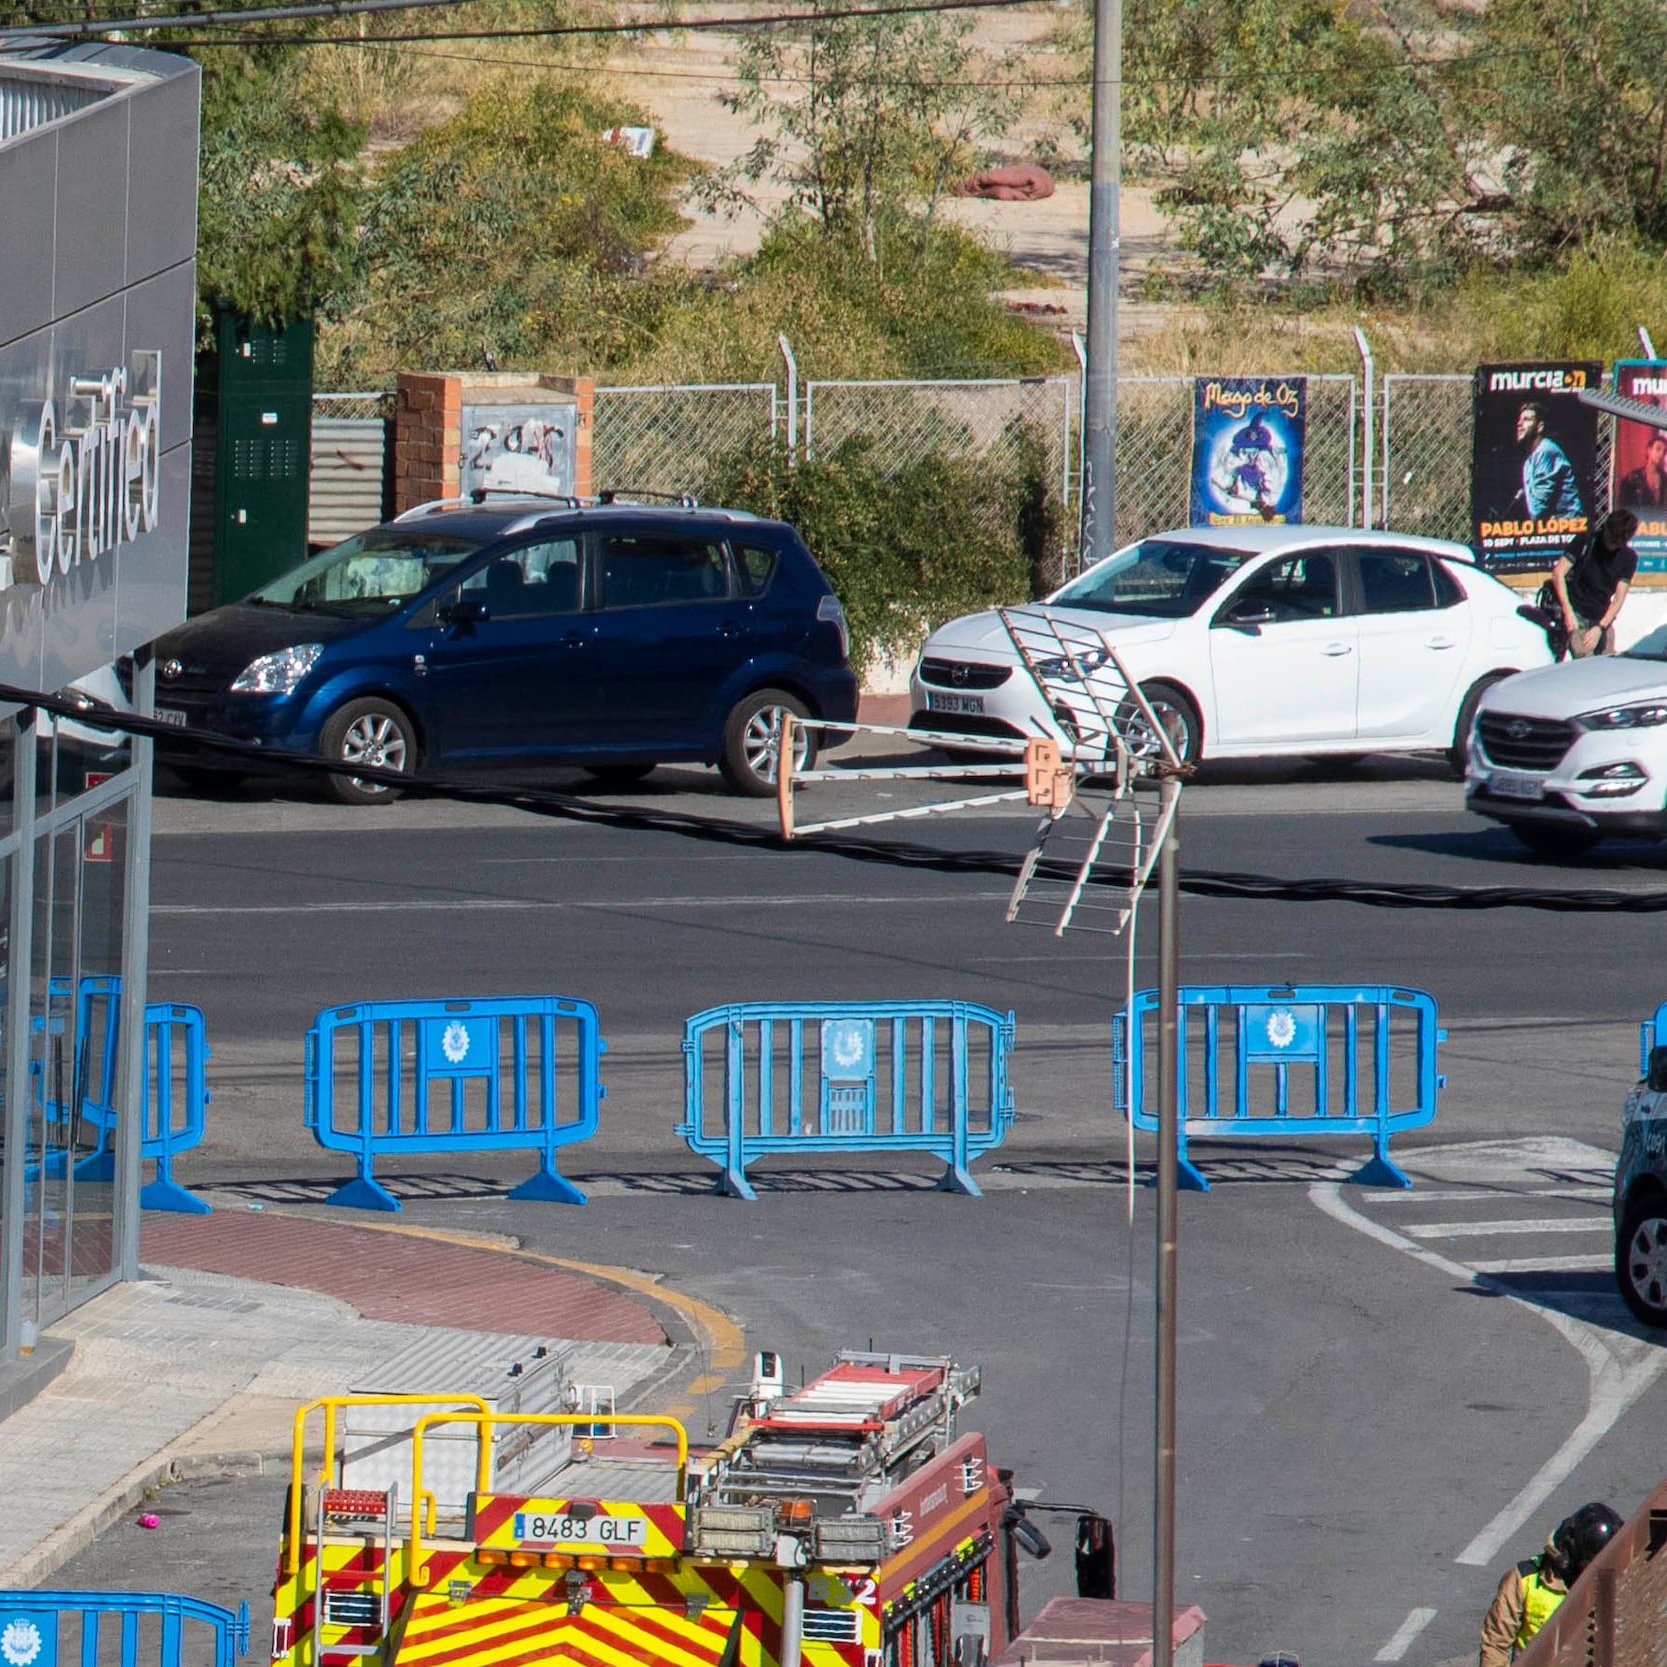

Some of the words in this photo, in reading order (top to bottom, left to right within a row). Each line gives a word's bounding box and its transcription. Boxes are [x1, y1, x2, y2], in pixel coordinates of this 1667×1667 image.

[1204, 382, 1253, 418] Mago
[1253, 385, 1277, 406] de
[1276, 382, 1299, 418] Oz
[35, 349, 162, 586] Certified
[1480, 520, 1535, 538] PABLO
[1536, 515, 1588, 533] LÓPEZ
[532, 1516, 587, 1539] 8483
[600, 1520, 641, 1541] GLF
